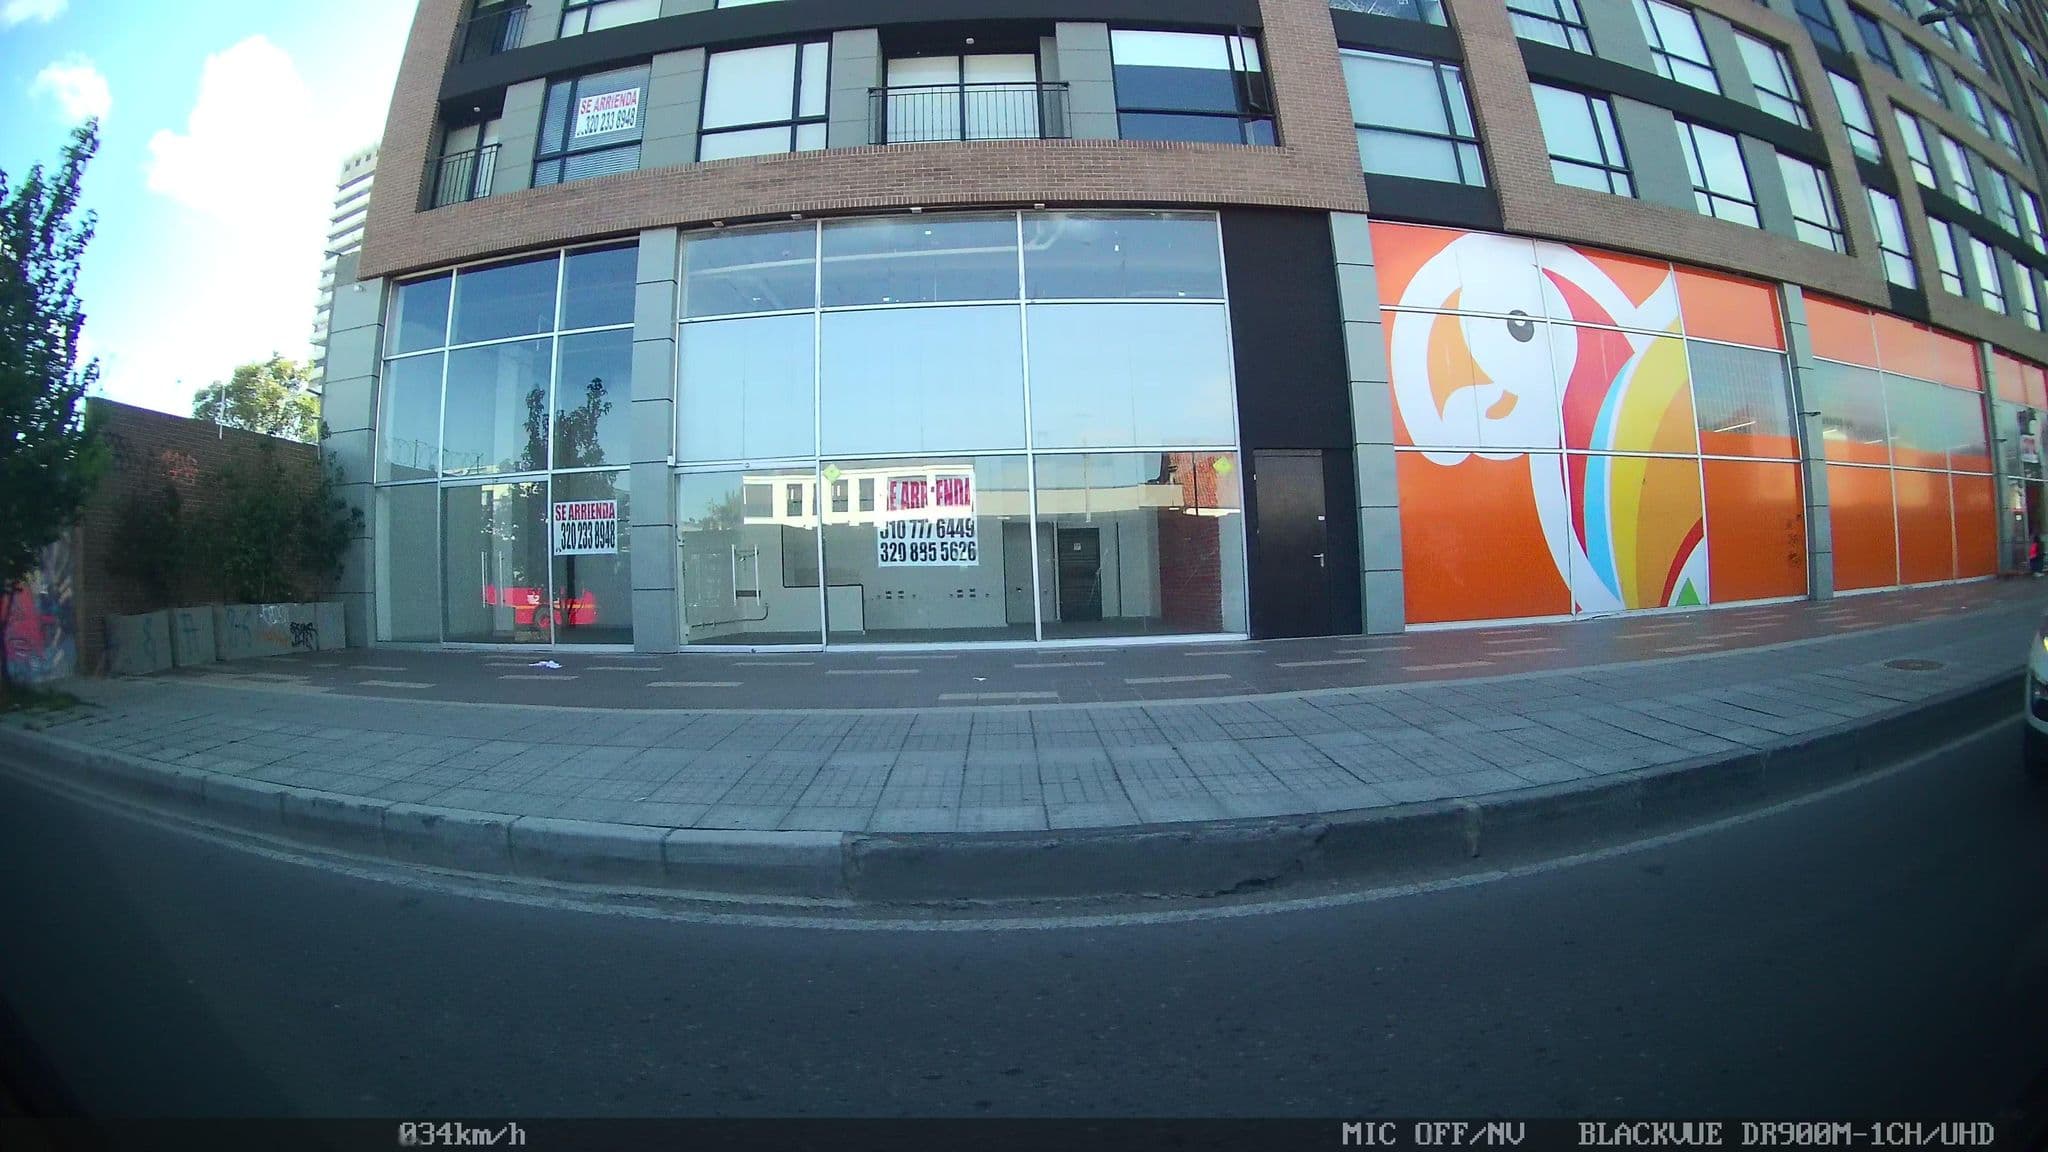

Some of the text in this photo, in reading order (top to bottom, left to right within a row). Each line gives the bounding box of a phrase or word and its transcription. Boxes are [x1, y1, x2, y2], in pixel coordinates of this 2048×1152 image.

[581, 90, 637, 114] SE ARRIENDA
[555, 502, 615, 521] SE ARRIENDA
[561, 520, 615, 550] 320 233 8948
[936, 517, 975, 539] 6449
[880, 541, 977, 562] 320 895 5626
